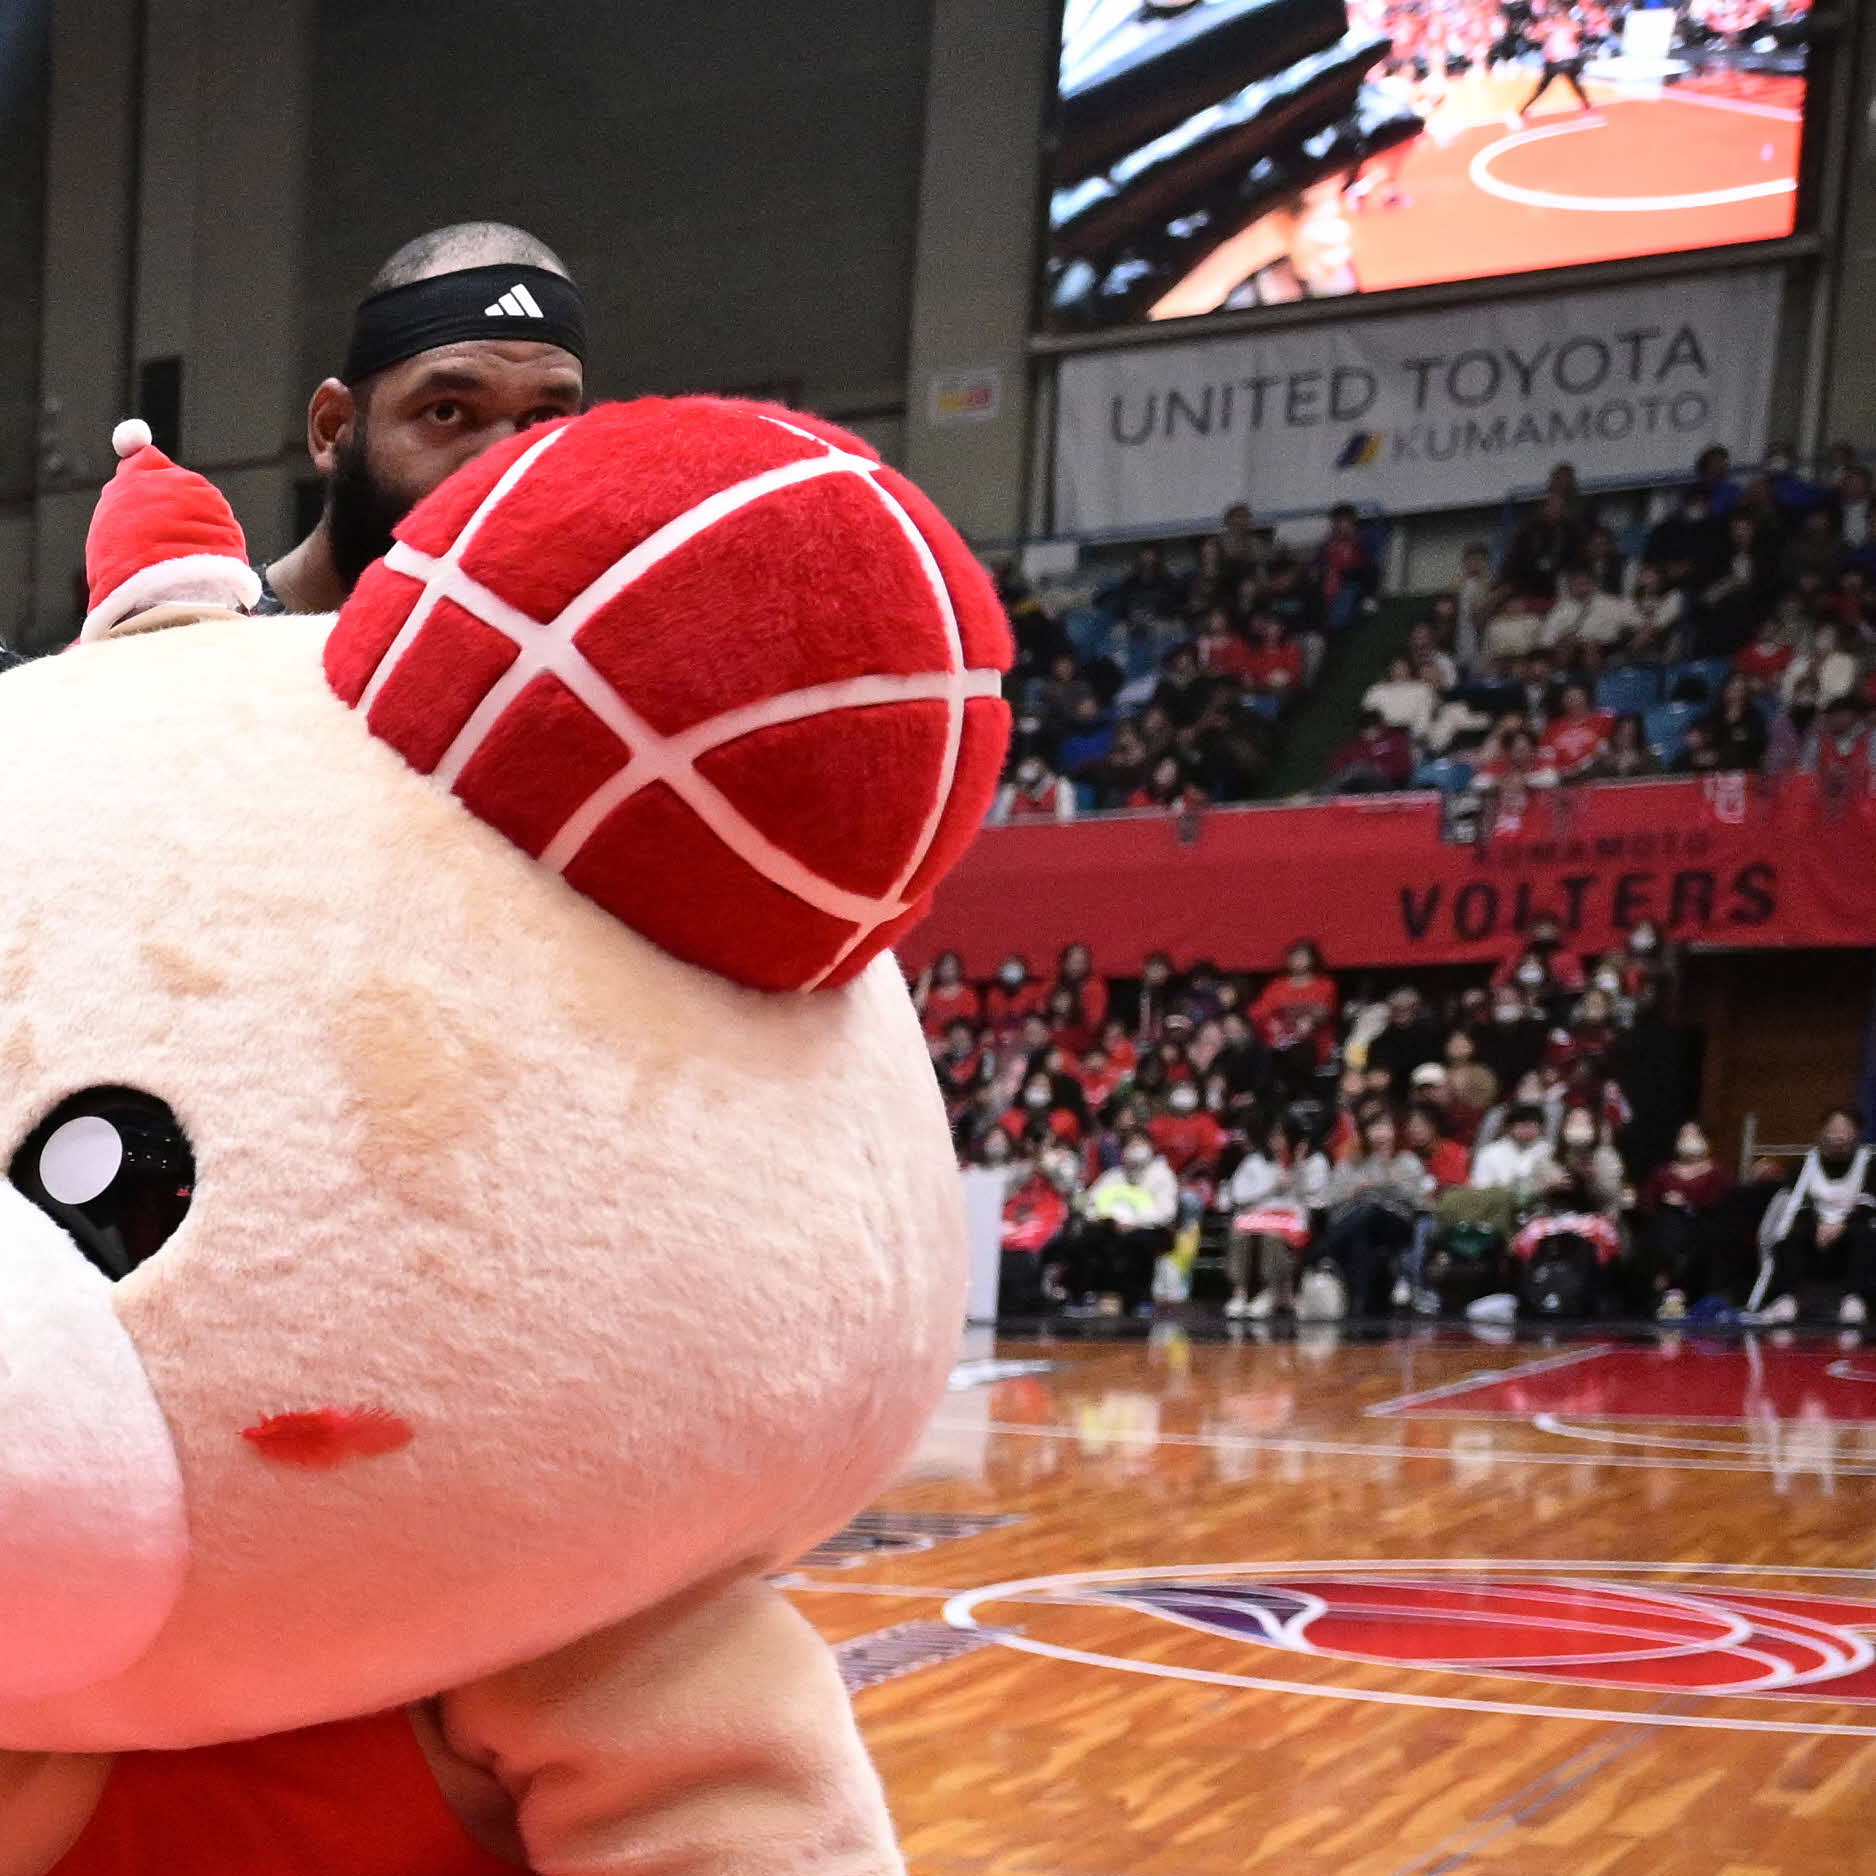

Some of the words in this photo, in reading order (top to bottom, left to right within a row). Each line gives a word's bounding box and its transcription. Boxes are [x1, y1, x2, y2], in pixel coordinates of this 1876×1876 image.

[1110, 364, 1378, 446] UNITED
[1403, 326, 1709, 411] TOYOTA
[1393, 392, 1709, 463] KUMAMOTO
[1399, 861, 1780, 942] VOLTERS
